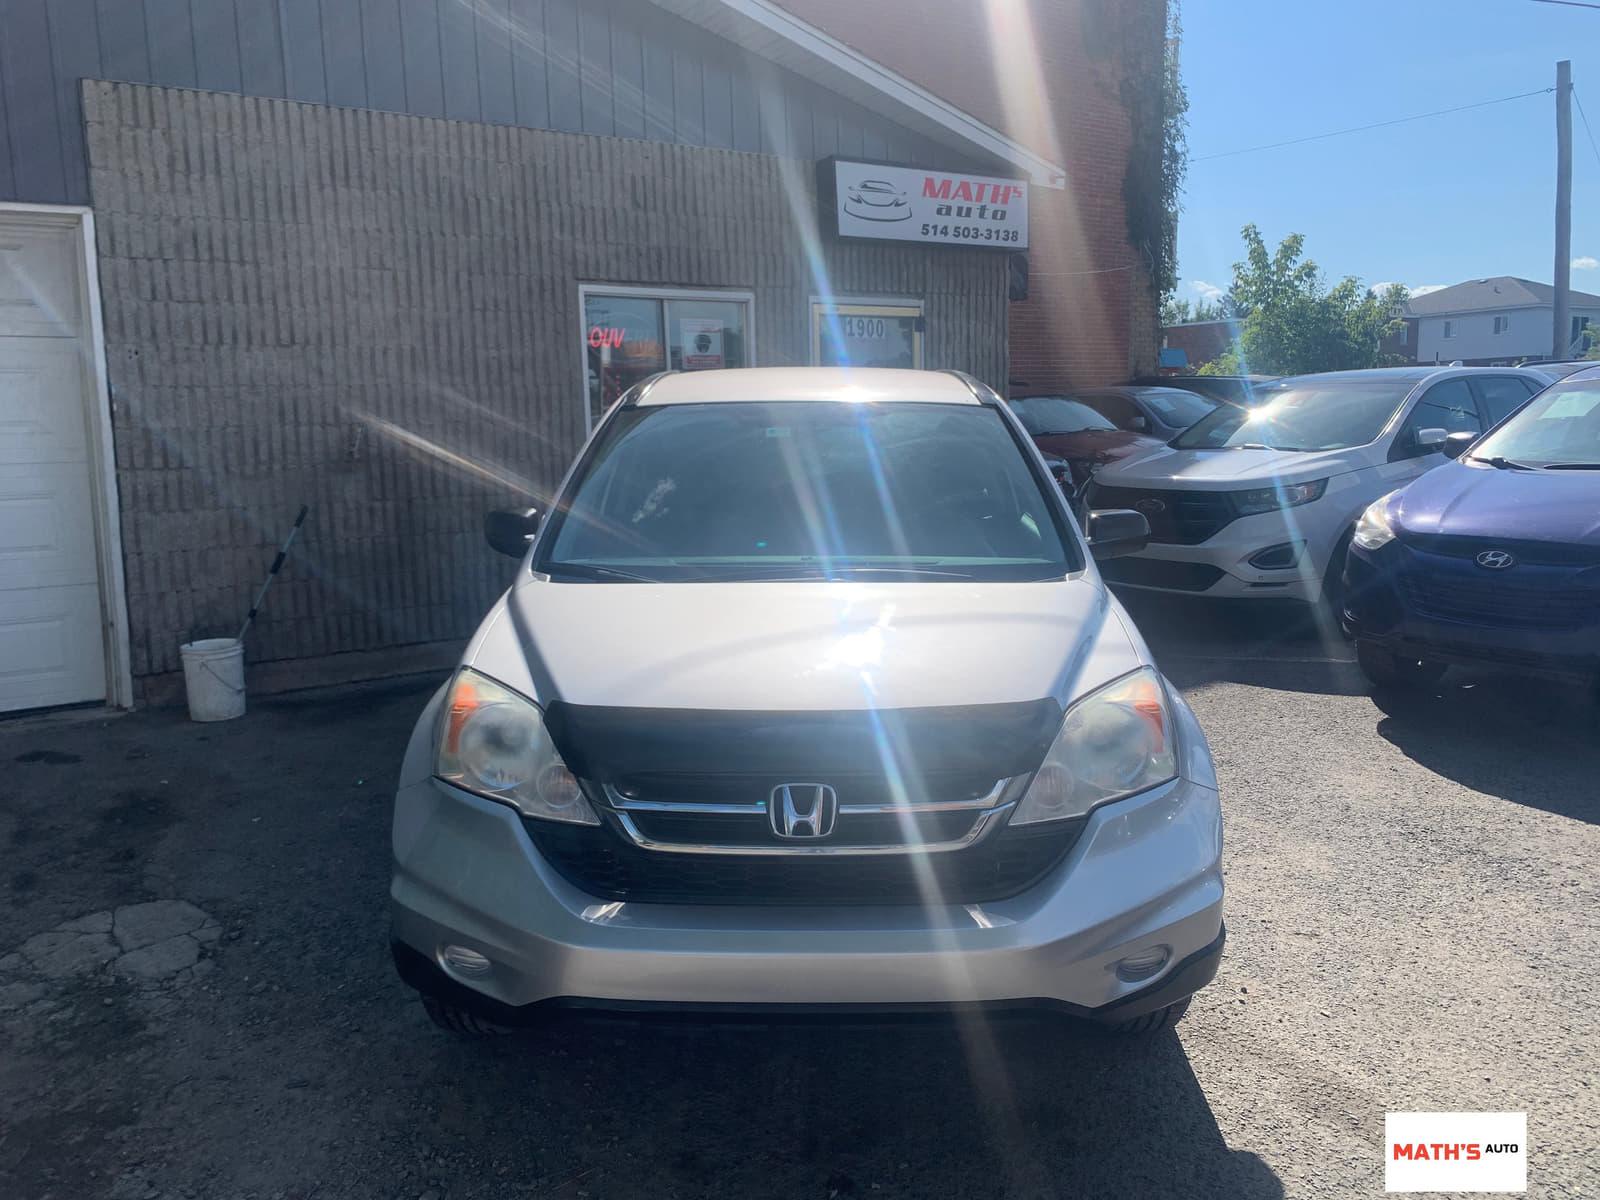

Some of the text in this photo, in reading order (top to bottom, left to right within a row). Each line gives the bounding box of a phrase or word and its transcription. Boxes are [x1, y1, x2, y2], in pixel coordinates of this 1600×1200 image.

[936, 204, 1007, 221] auto
[921, 223, 1019, 242] 514 503-3138
[847, 318, 884, 337] 1900
